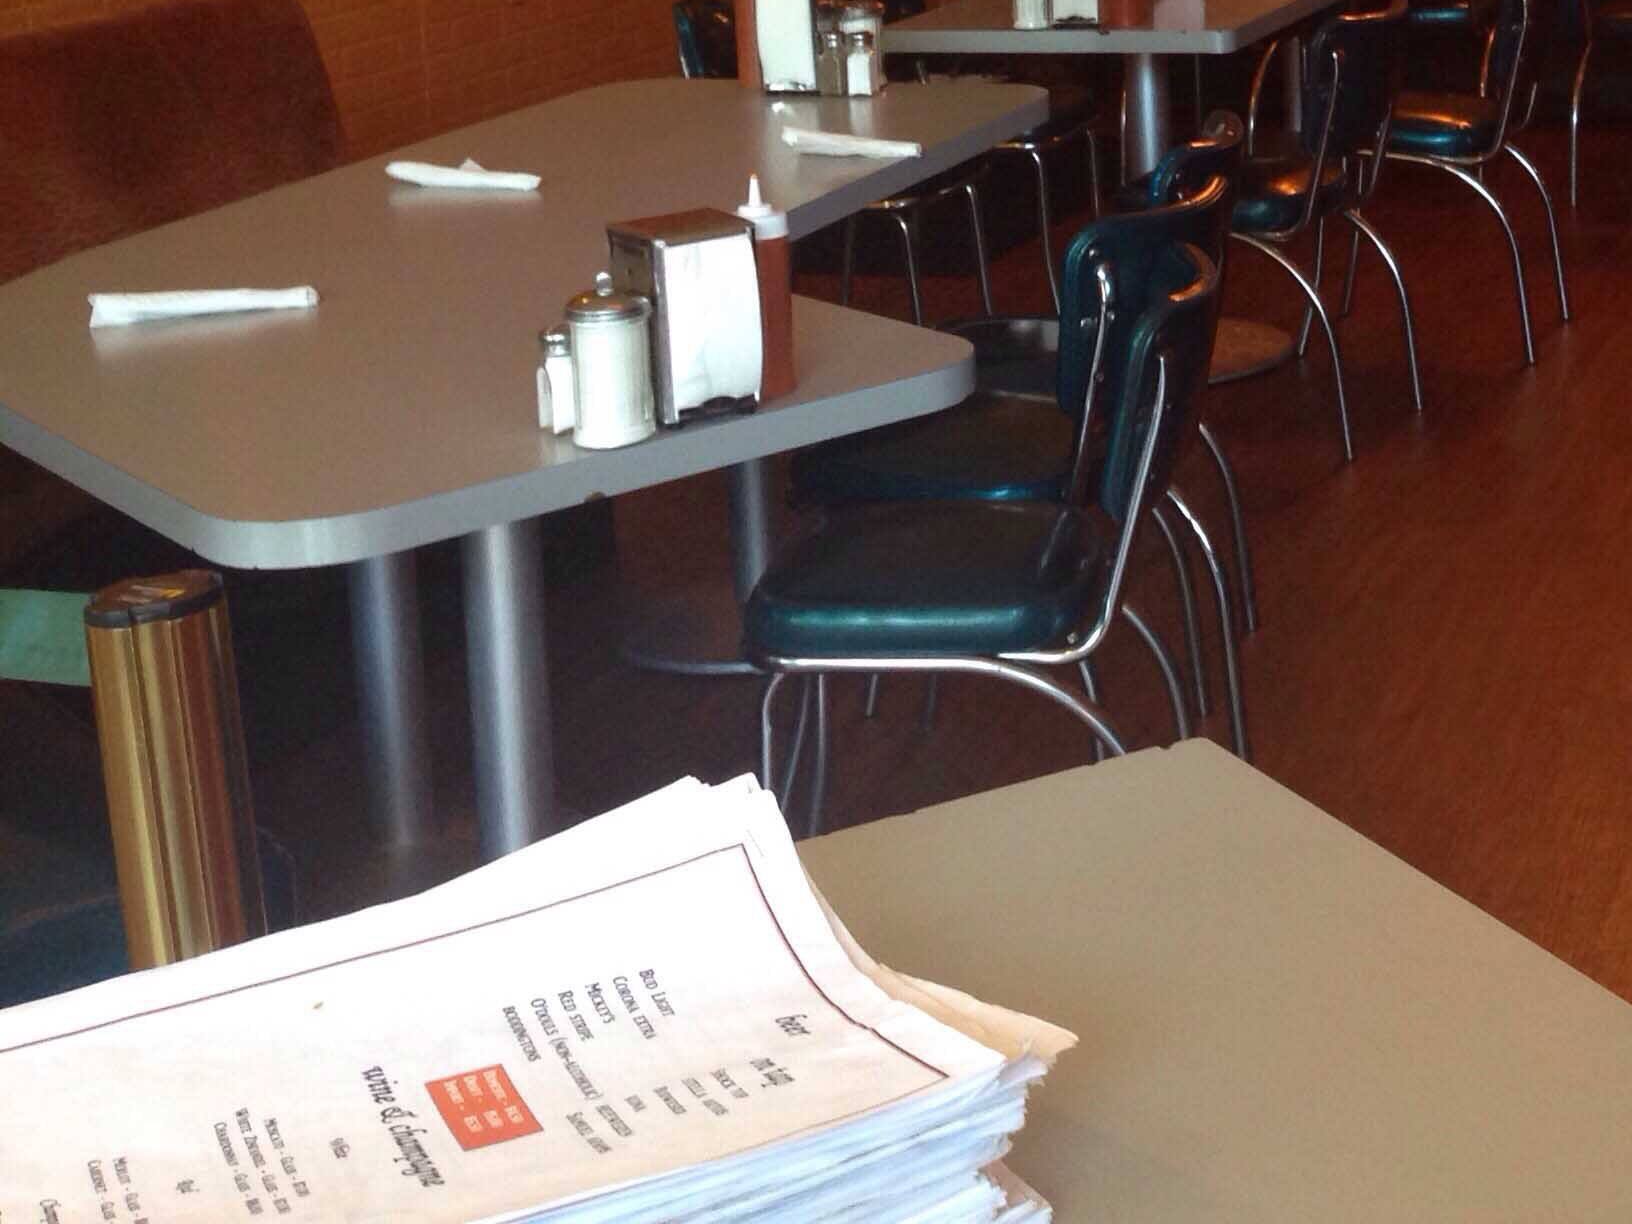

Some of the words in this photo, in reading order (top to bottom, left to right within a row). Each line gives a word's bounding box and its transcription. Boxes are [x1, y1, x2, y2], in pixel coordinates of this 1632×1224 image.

[639, 968, 658, 989] BUD
[558, 990, 576, 1011] RED
[612, 975, 640, 1013] CORONA
[362, 1065, 398, 1104] wine
[388, 1124, 445, 1187] champagne
